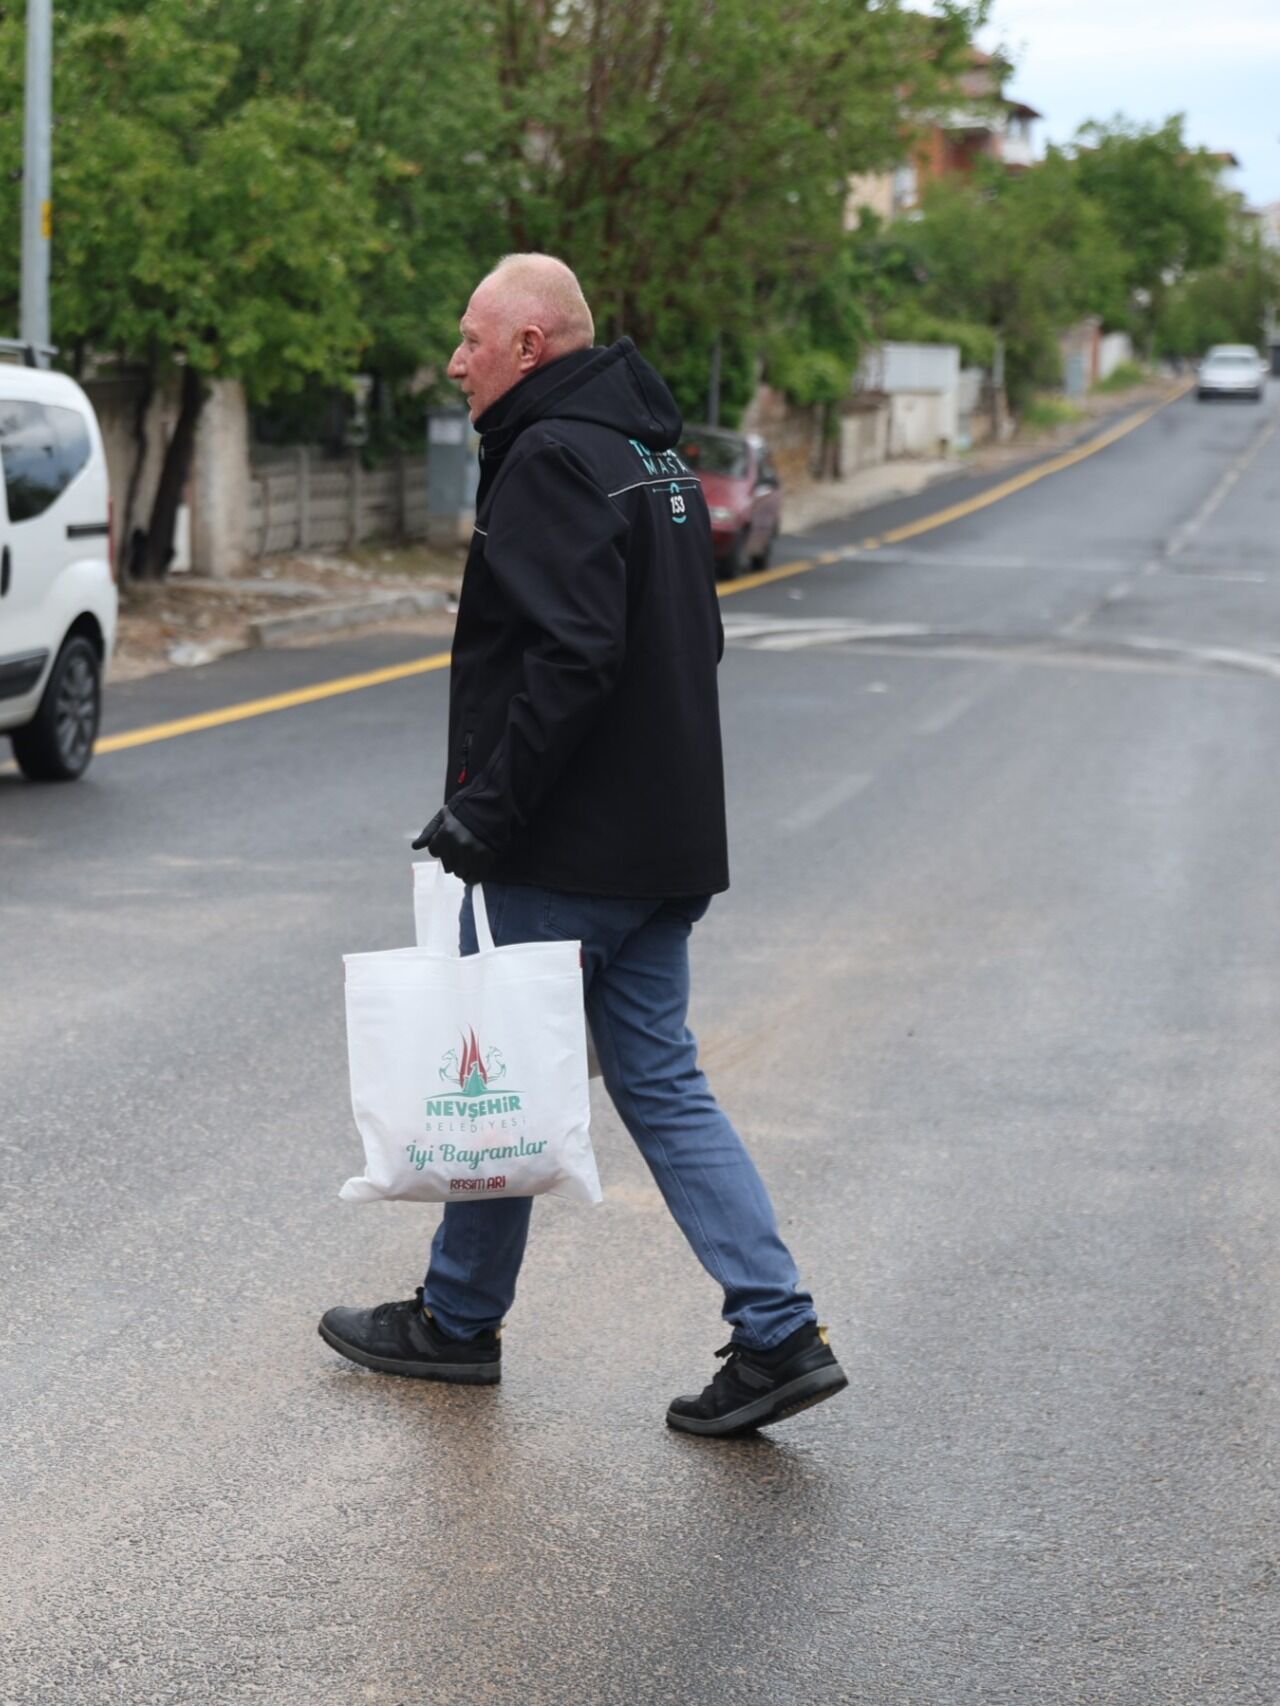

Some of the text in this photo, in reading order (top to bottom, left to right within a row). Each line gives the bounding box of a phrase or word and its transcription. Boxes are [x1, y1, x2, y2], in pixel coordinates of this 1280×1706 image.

[642, 457, 689, 476] MASA
[670, 495, 686, 514] 153
[439, 1136, 548, 1170] Bayramlar
[486, 1175, 506, 1190] ARI
